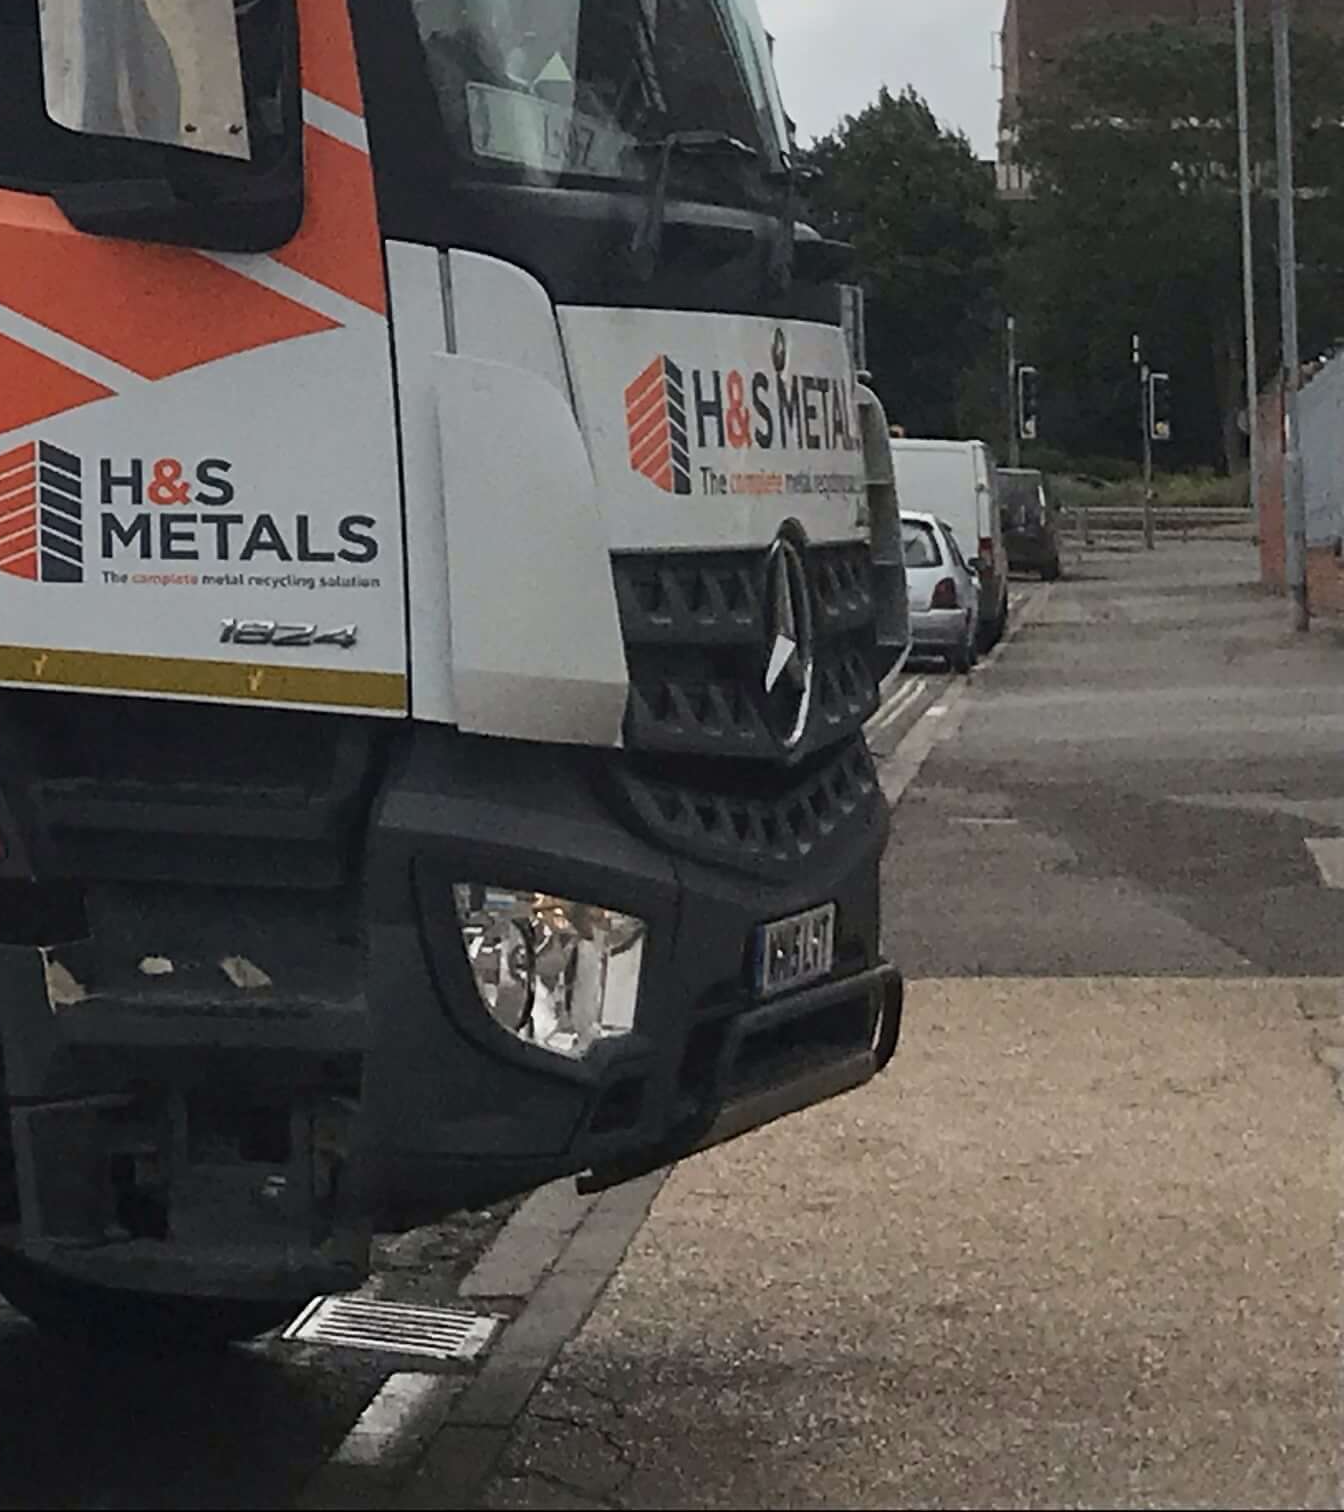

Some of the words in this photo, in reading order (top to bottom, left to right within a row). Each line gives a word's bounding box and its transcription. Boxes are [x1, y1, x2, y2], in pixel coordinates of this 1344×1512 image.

[691, 369, 773, 449] H&S
[776, 373, 863, 452] METAL
[99, 457, 235, 506] H&S
[100, 511, 379, 564] METALS
[101, 571, 129, 585] The
[131, 571, 199, 586] complete
[201, 572, 244, 586] metal
[247, 574, 316, 590] recycling
[318, 574, 381, 589] solution
[219, 617, 358, 650] 1824
